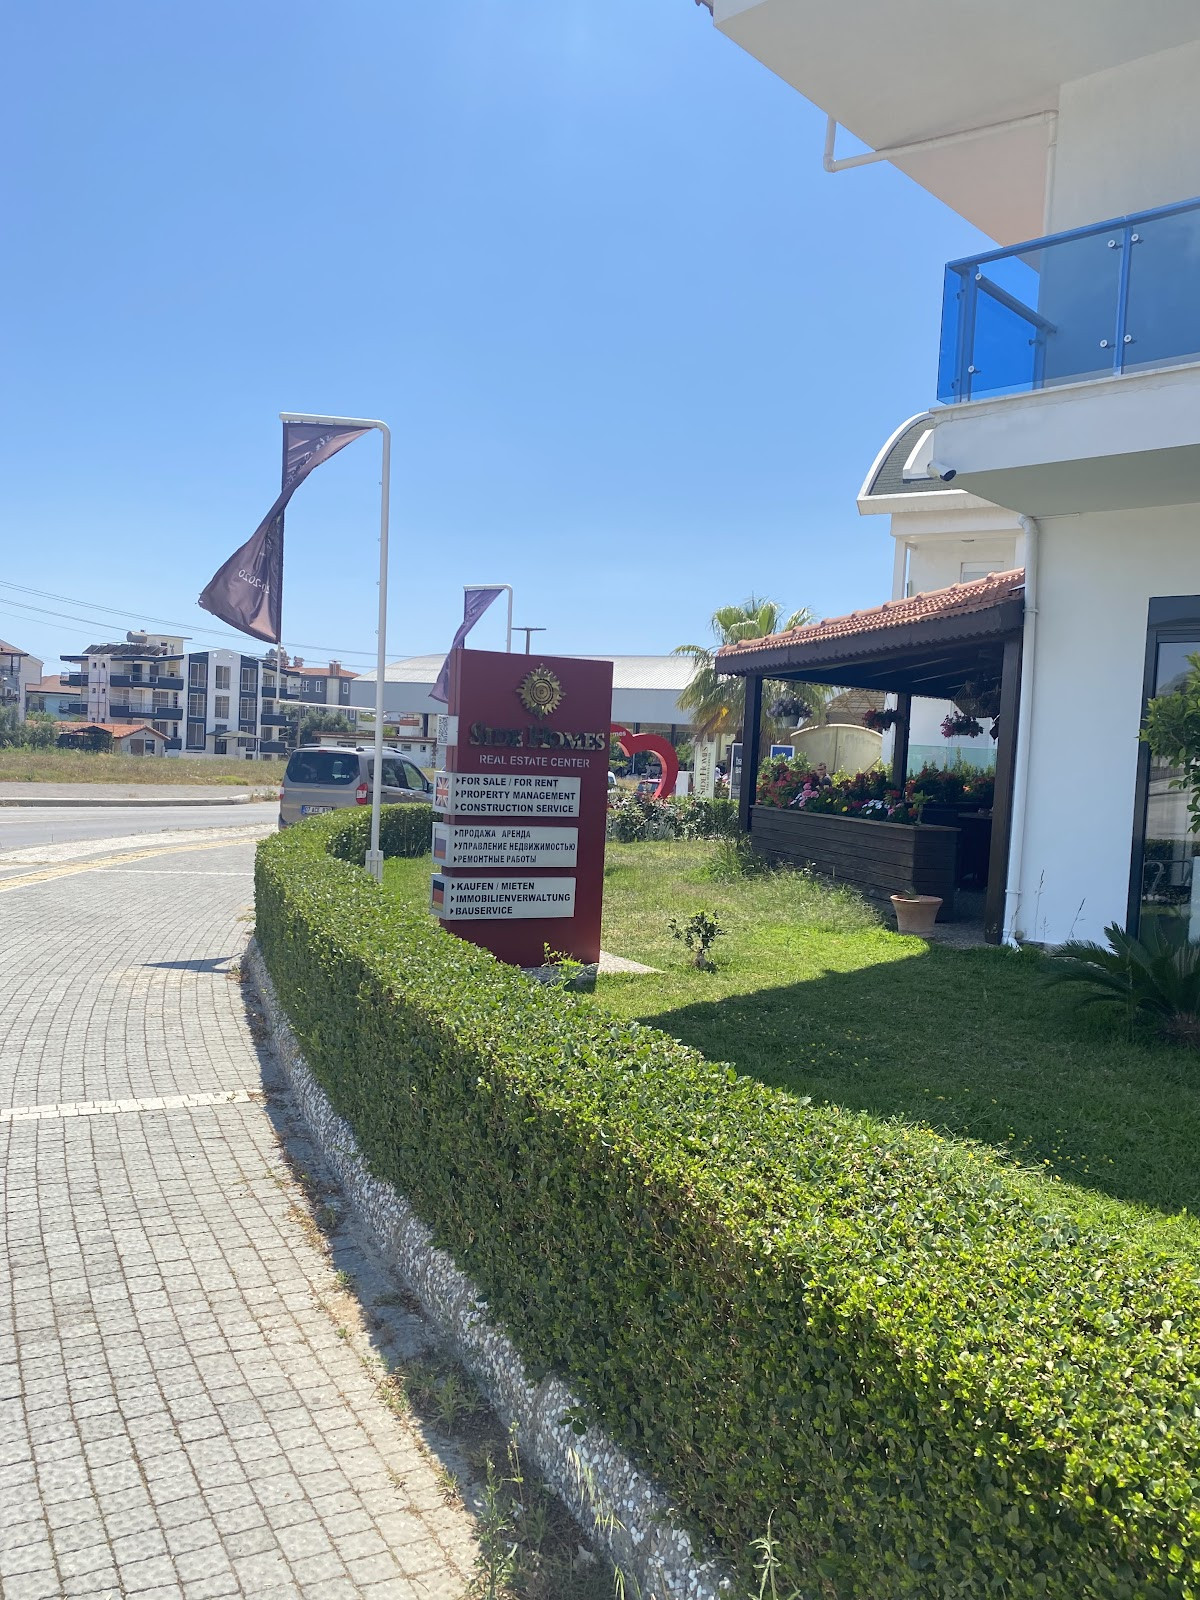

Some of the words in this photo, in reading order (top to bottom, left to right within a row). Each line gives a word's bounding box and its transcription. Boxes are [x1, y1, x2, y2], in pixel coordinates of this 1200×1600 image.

[479, 755, 506, 765] REAL
[510, 755, 547, 767] ESTATE
[551, 757, 589, 768] CENTER
[462, 777, 480, 785] FOR
[483, 778, 506, 786] SALE
[514, 778, 532, 786] FOR
[535, 779, 558, 787] RENT
[460, 790, 510, 799] PROPERTY
[513, 792, 576, 800] MANAGEMENT
[460, 803, 533, 813] CONSTRUCTION
[536, 805, 574, 813] SERVICE
[459, 829, 496, 839] ПРОДАЖА
[502, 830, 530, 839] АРЕНДА
[458, 842, 507, 850] УПРАВЛЕНИЕ
[509, 842, 575, 851] НЕДВИЖИМОСТЬЮ
[457, 855, 504, 863] РЕМОНТНЫЕ
[506, 855, 537, 863] РАБОТЫ
[501, 882, 535, 890] MIETEN
[456, 893, 570, 903] IMMOBILIENVERWALTUNG
[455, 906, 513, 915] BAUSERVICE
